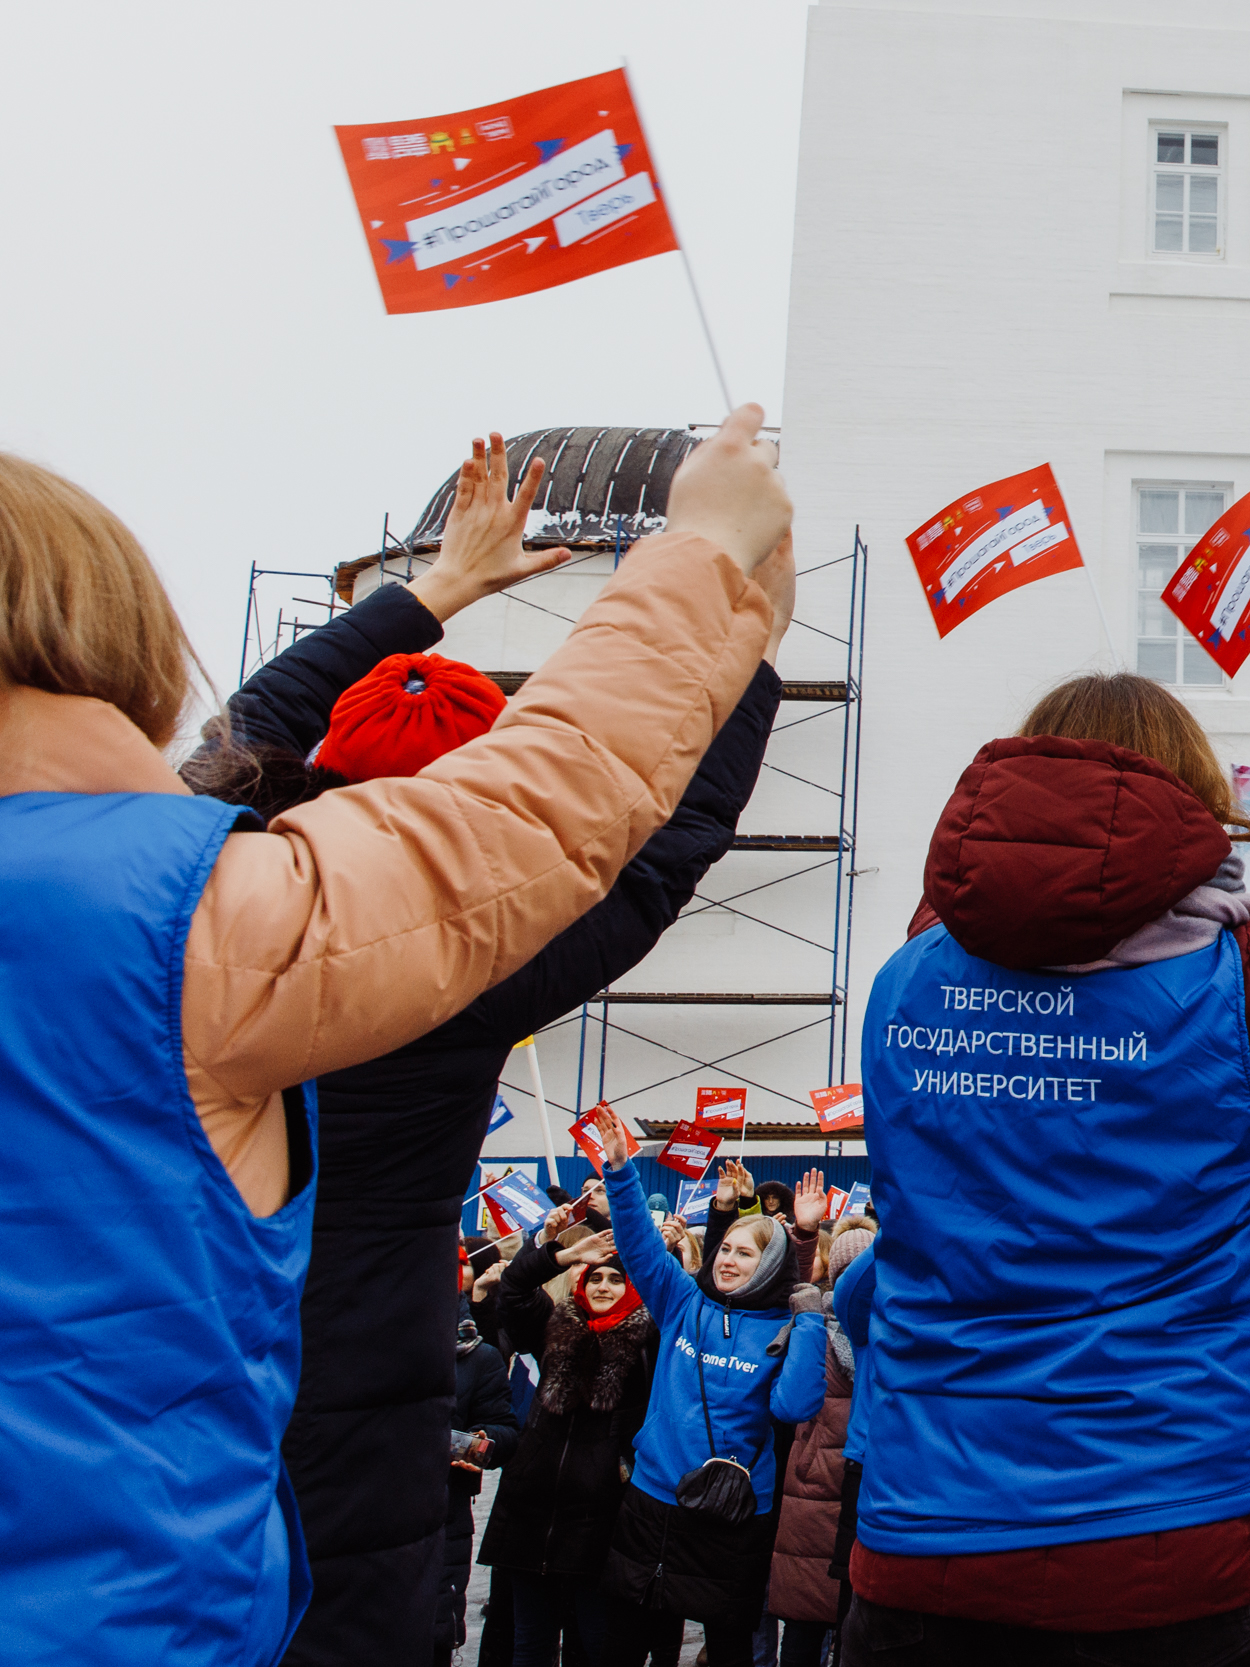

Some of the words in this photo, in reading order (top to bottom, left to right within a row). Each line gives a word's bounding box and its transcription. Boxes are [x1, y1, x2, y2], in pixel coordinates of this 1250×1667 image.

[421, 157, 611, 249] #ПрошагайГород
[575, 193, 636, 226] Тверь
[946, 515, 1041, 589] #ПрошагайГород
[1022, 533, 1058, 554] Тверь
[940, 985, 1075, 1017] ТВЕРСКОЙ
[886, 1024, 1148, 1062] ГОСУДАРСТВЕННЫЙ
[911, 1068, 1102, 1102] УНИВЕРСИТЕТ
